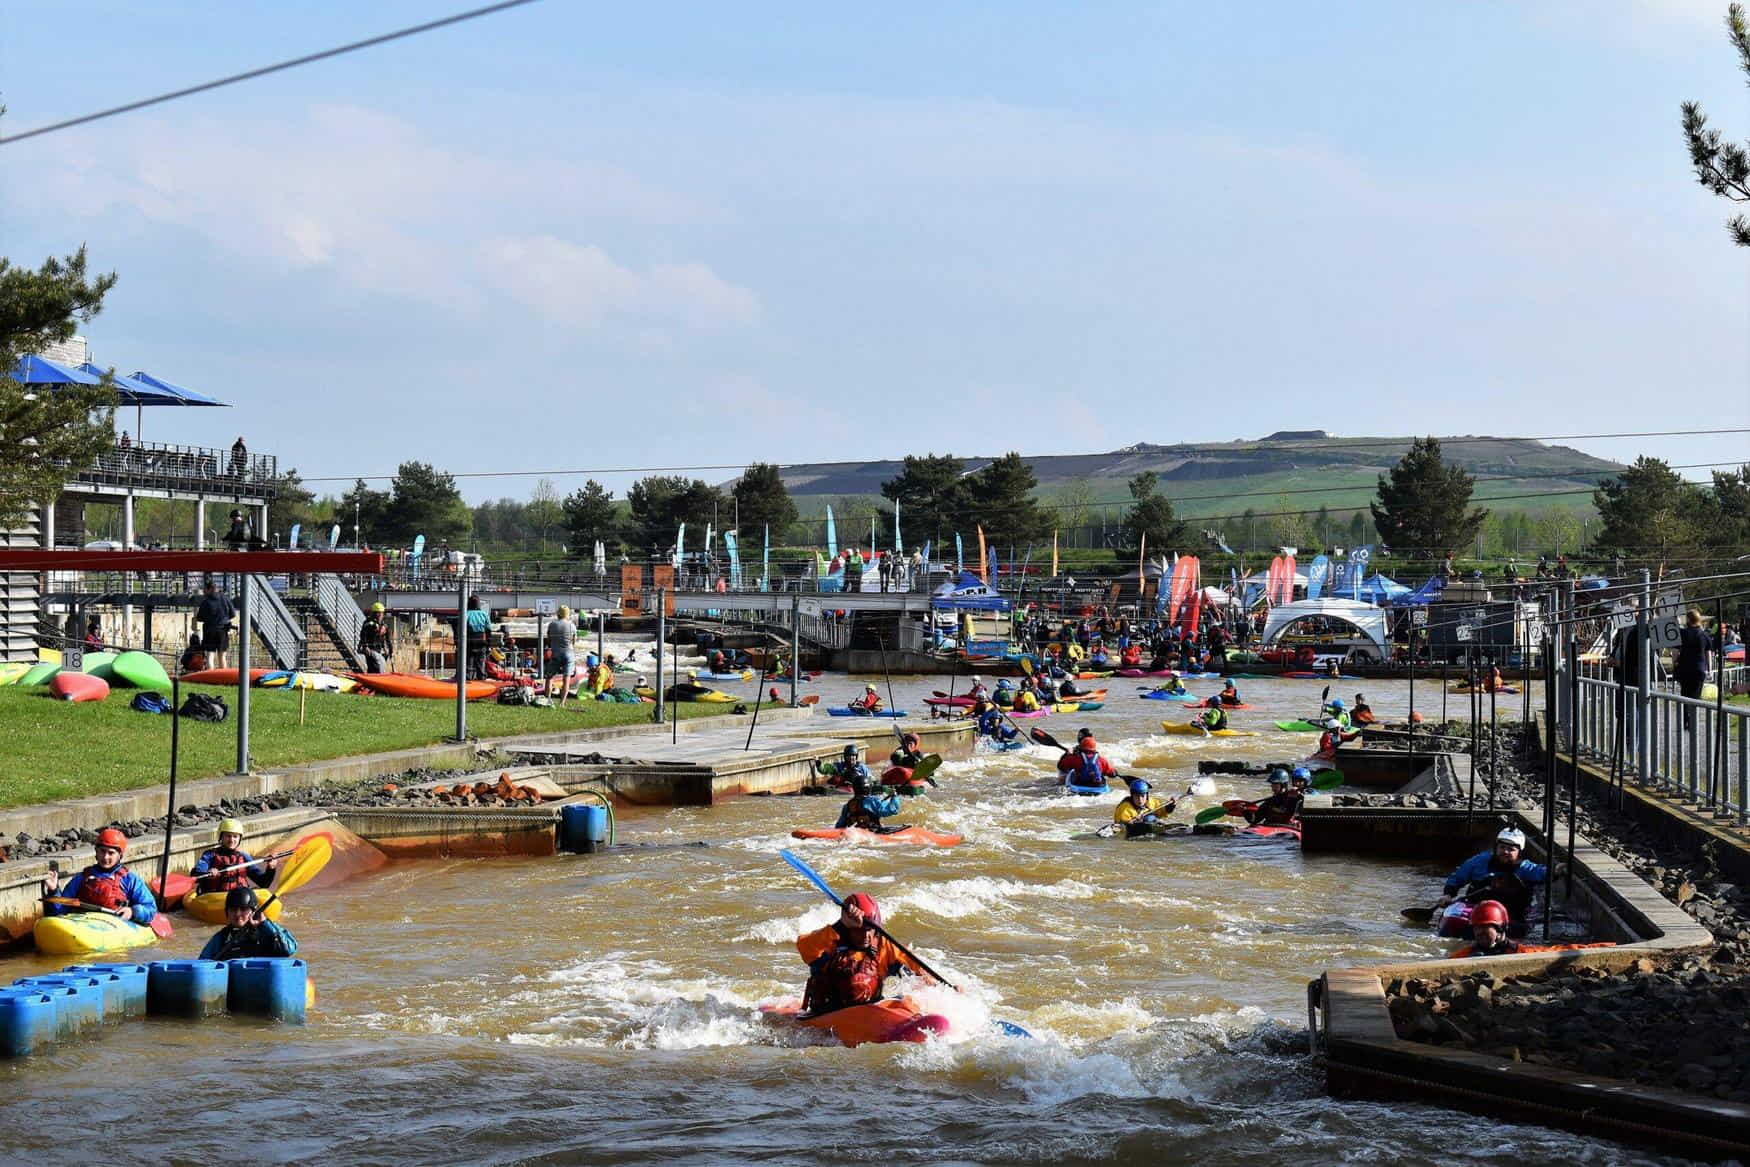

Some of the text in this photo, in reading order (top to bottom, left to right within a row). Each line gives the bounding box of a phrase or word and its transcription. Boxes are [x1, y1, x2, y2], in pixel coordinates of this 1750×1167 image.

[1660, 594, 1681, 616] 17
[1616, 608, 1634, 625] 19
[1651, 621, 1679, 643] 16
[63, 652, 82, 668] 18
